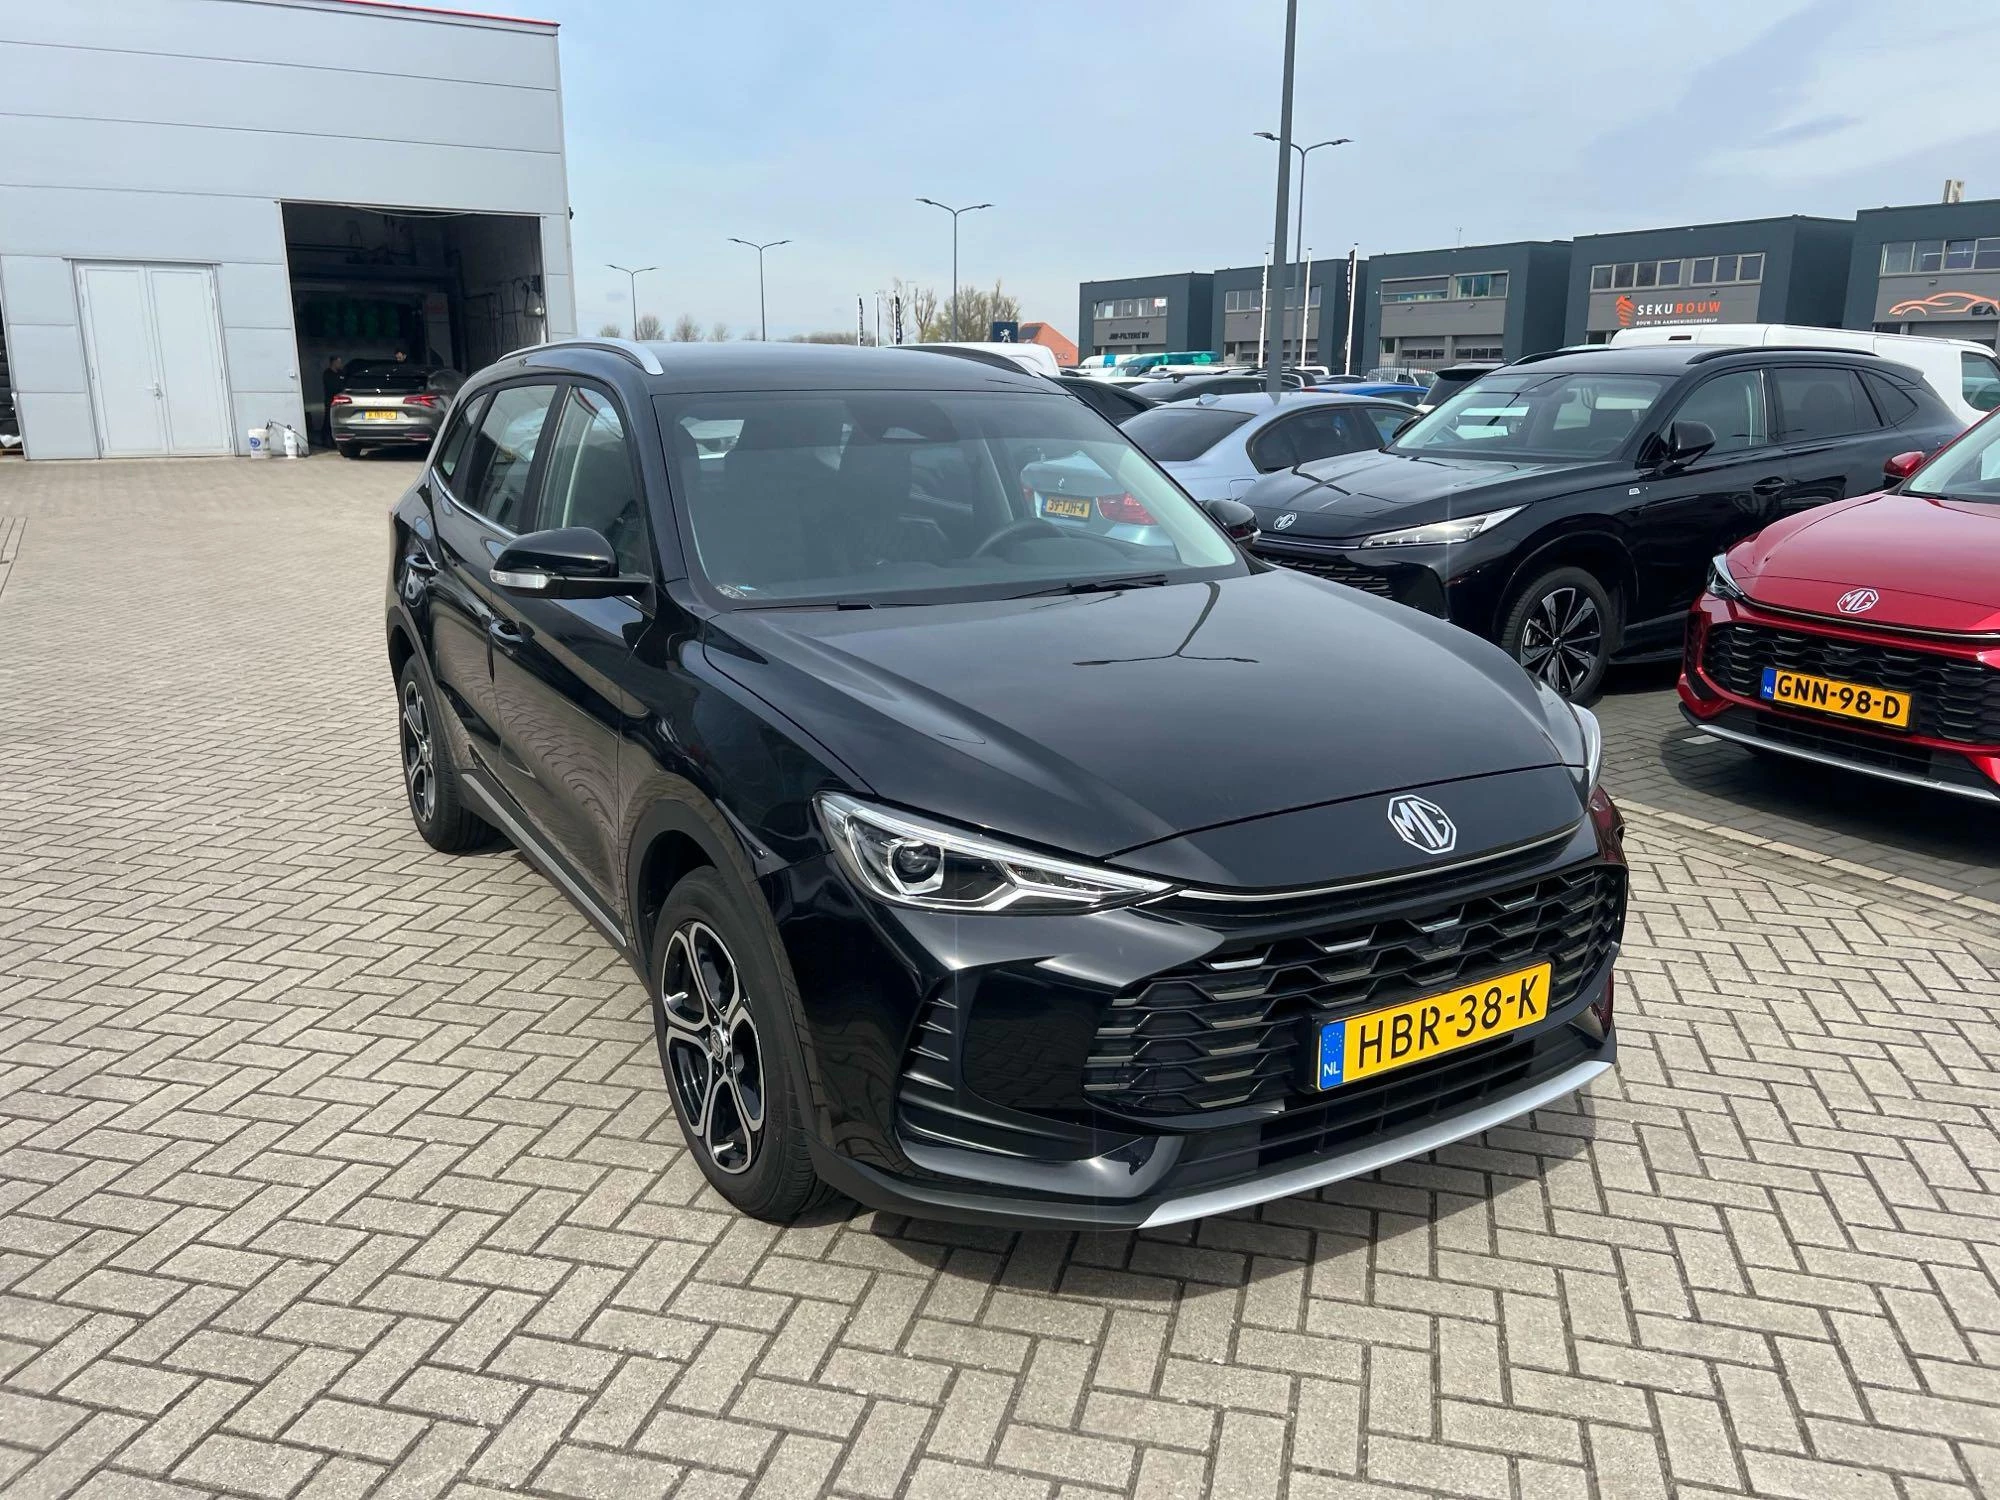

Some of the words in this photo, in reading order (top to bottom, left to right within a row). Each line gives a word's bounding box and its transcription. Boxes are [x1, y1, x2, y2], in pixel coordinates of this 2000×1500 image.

[1637, 302, 1720, 315] SEKUBOUW
[1839, 589, 1877, 612] MG
[1763, 685, 1774, 694] NL
[1777, 675, 1901, 719] GNN-98-D
[1391, 798, 1453, 850] MG
[1323, 1061, 1340, 1077] NL
[1358, 974, 1539, 1069] HBR-38-K
